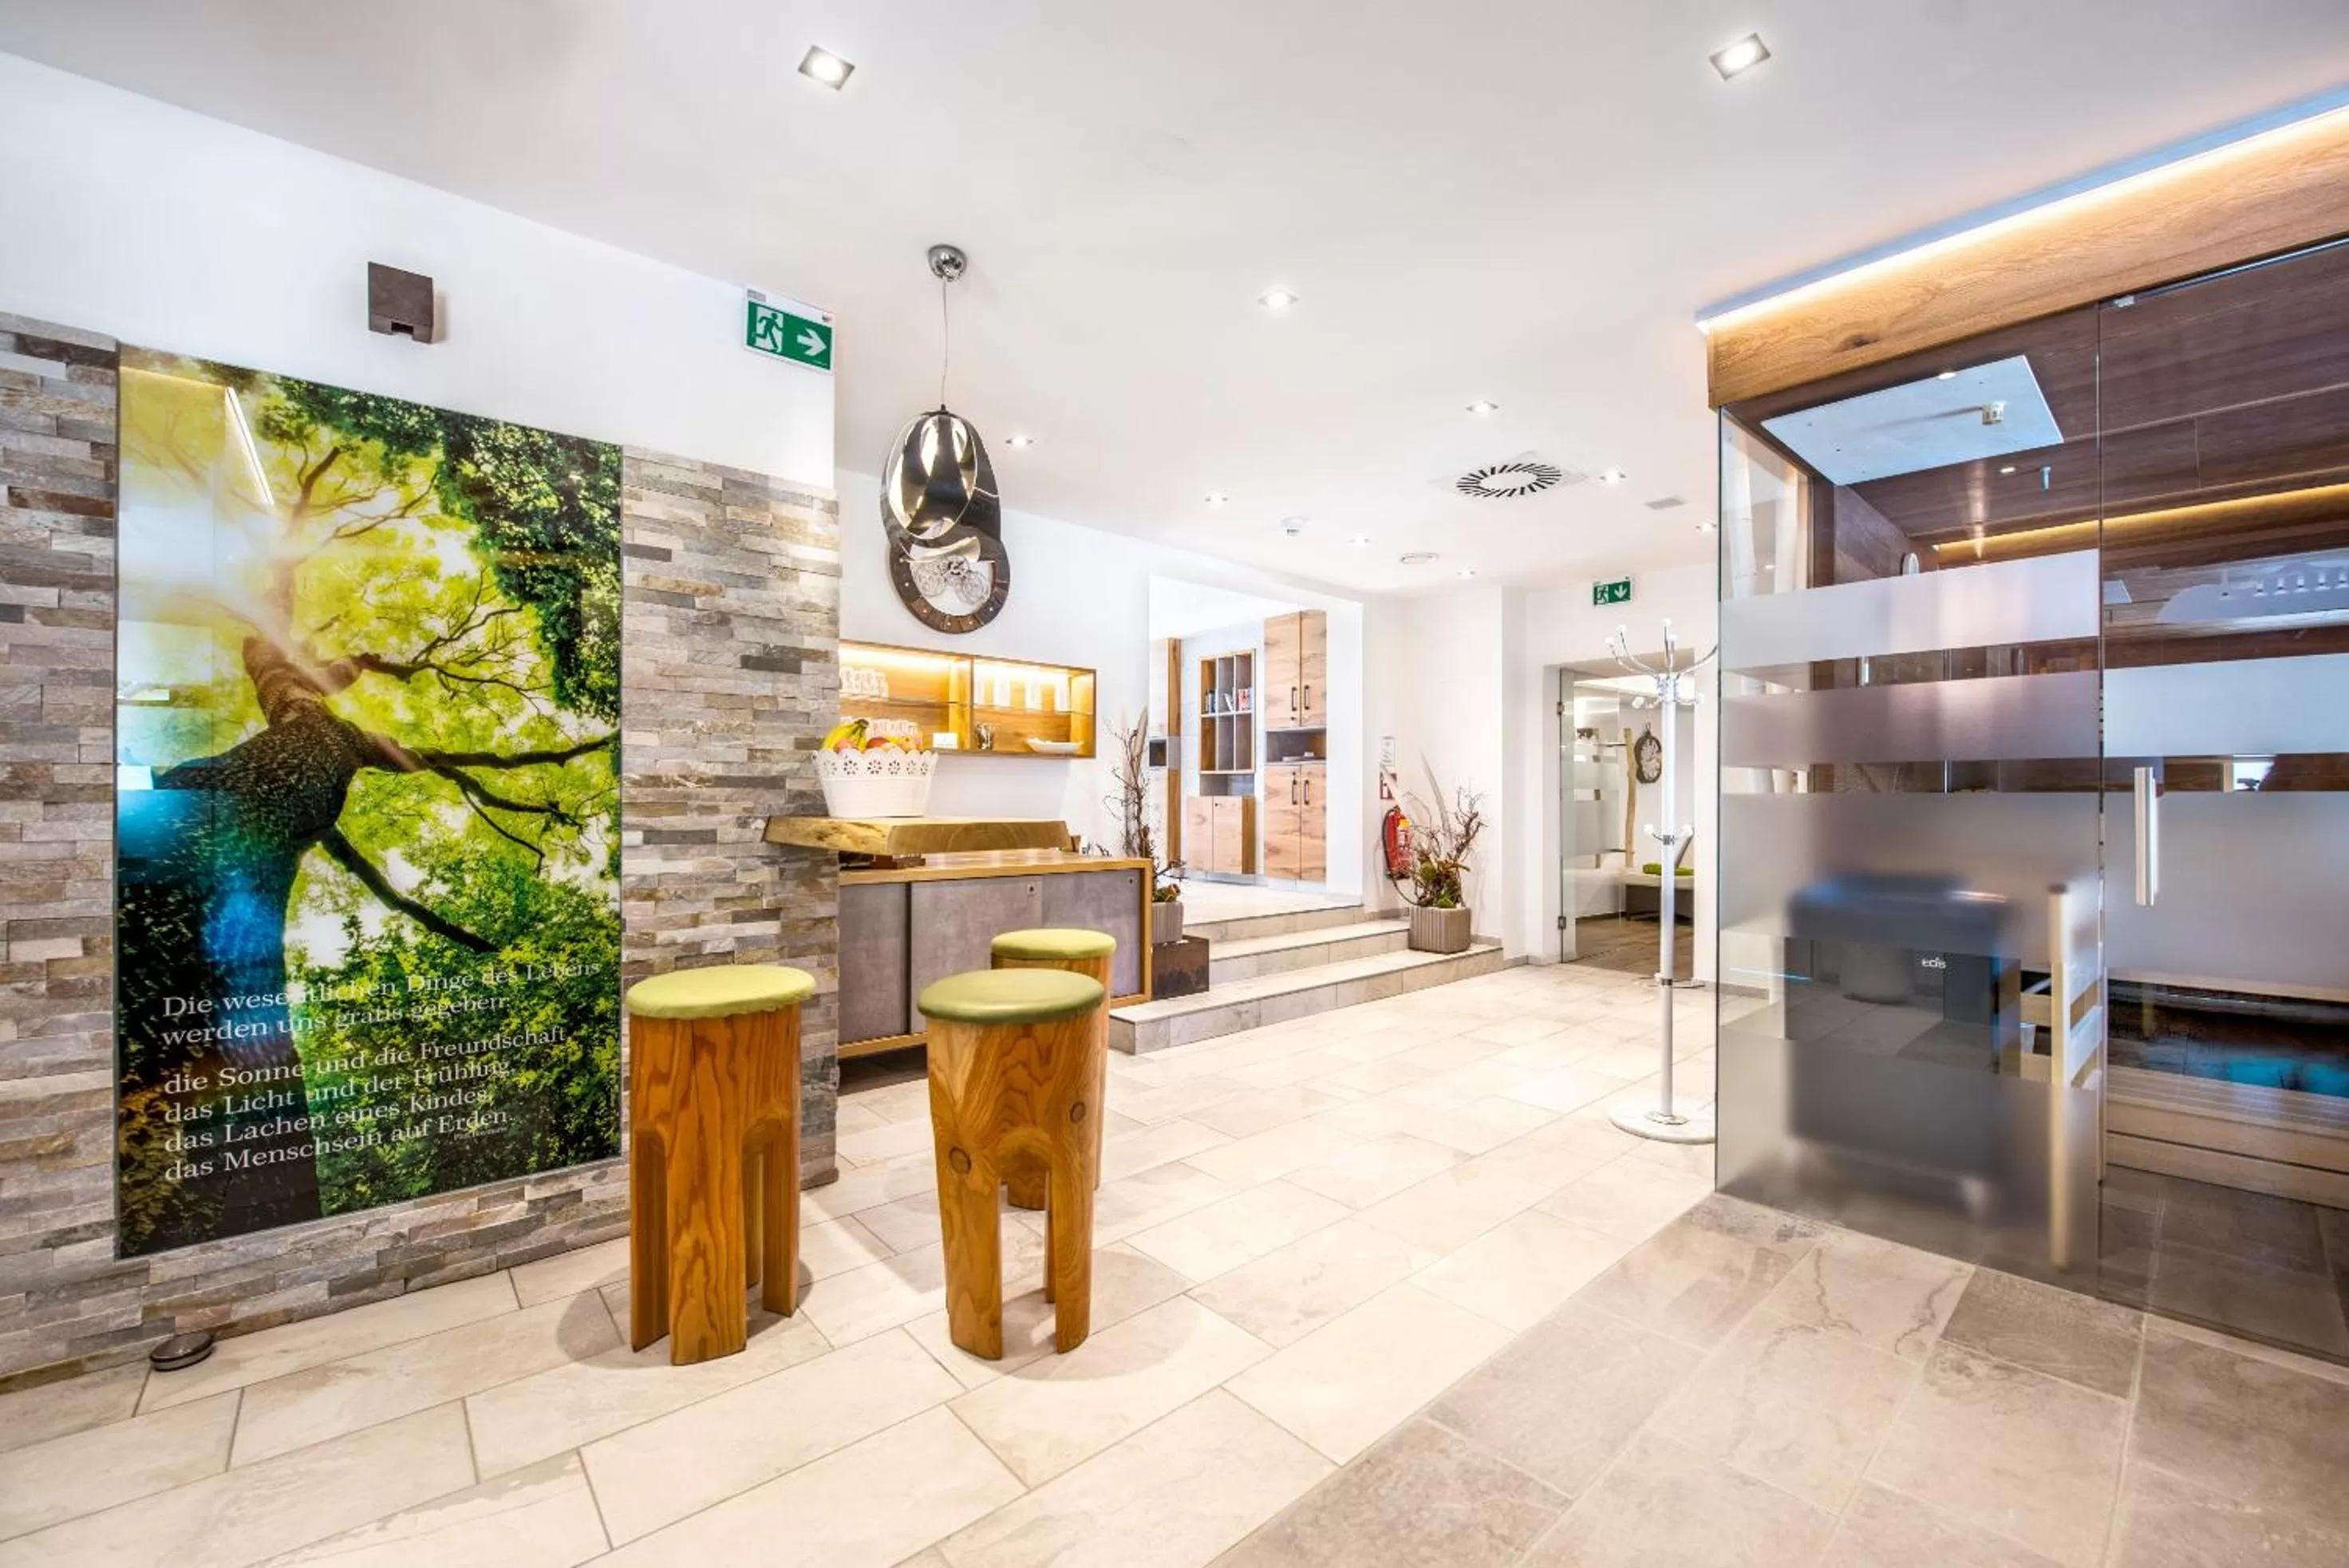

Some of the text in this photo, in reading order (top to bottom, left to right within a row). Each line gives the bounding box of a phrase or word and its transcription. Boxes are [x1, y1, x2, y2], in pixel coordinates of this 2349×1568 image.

[163, 995, 212, 1017] Die
[406, 972, 474, 993] Dinge
[482, 962, 518, 985] des
[162, 1020, 267, 1046] werden
[278, 1017, 326, 1033] uns
[335, 1005, 403, 1031] gratis
[164, 1026, 565, 1094] die Sonne und die Freundschaft
[164, 1103, 213, 1124] das
[224, 1089, 295, 1114] Licht
[308, 1081, 356, 1102] und
[365, 1075, 403, 1093] der
[165, 1132, 213, 1153] das
[225, 1114, 326, 1143] Lachen
[335, 1102, 400, 1124] eines
[165, 1161, 213, 1182] das
[224, 1131, 382, 1171] Menschsein
[391, 1118, 432, 1142] auf
